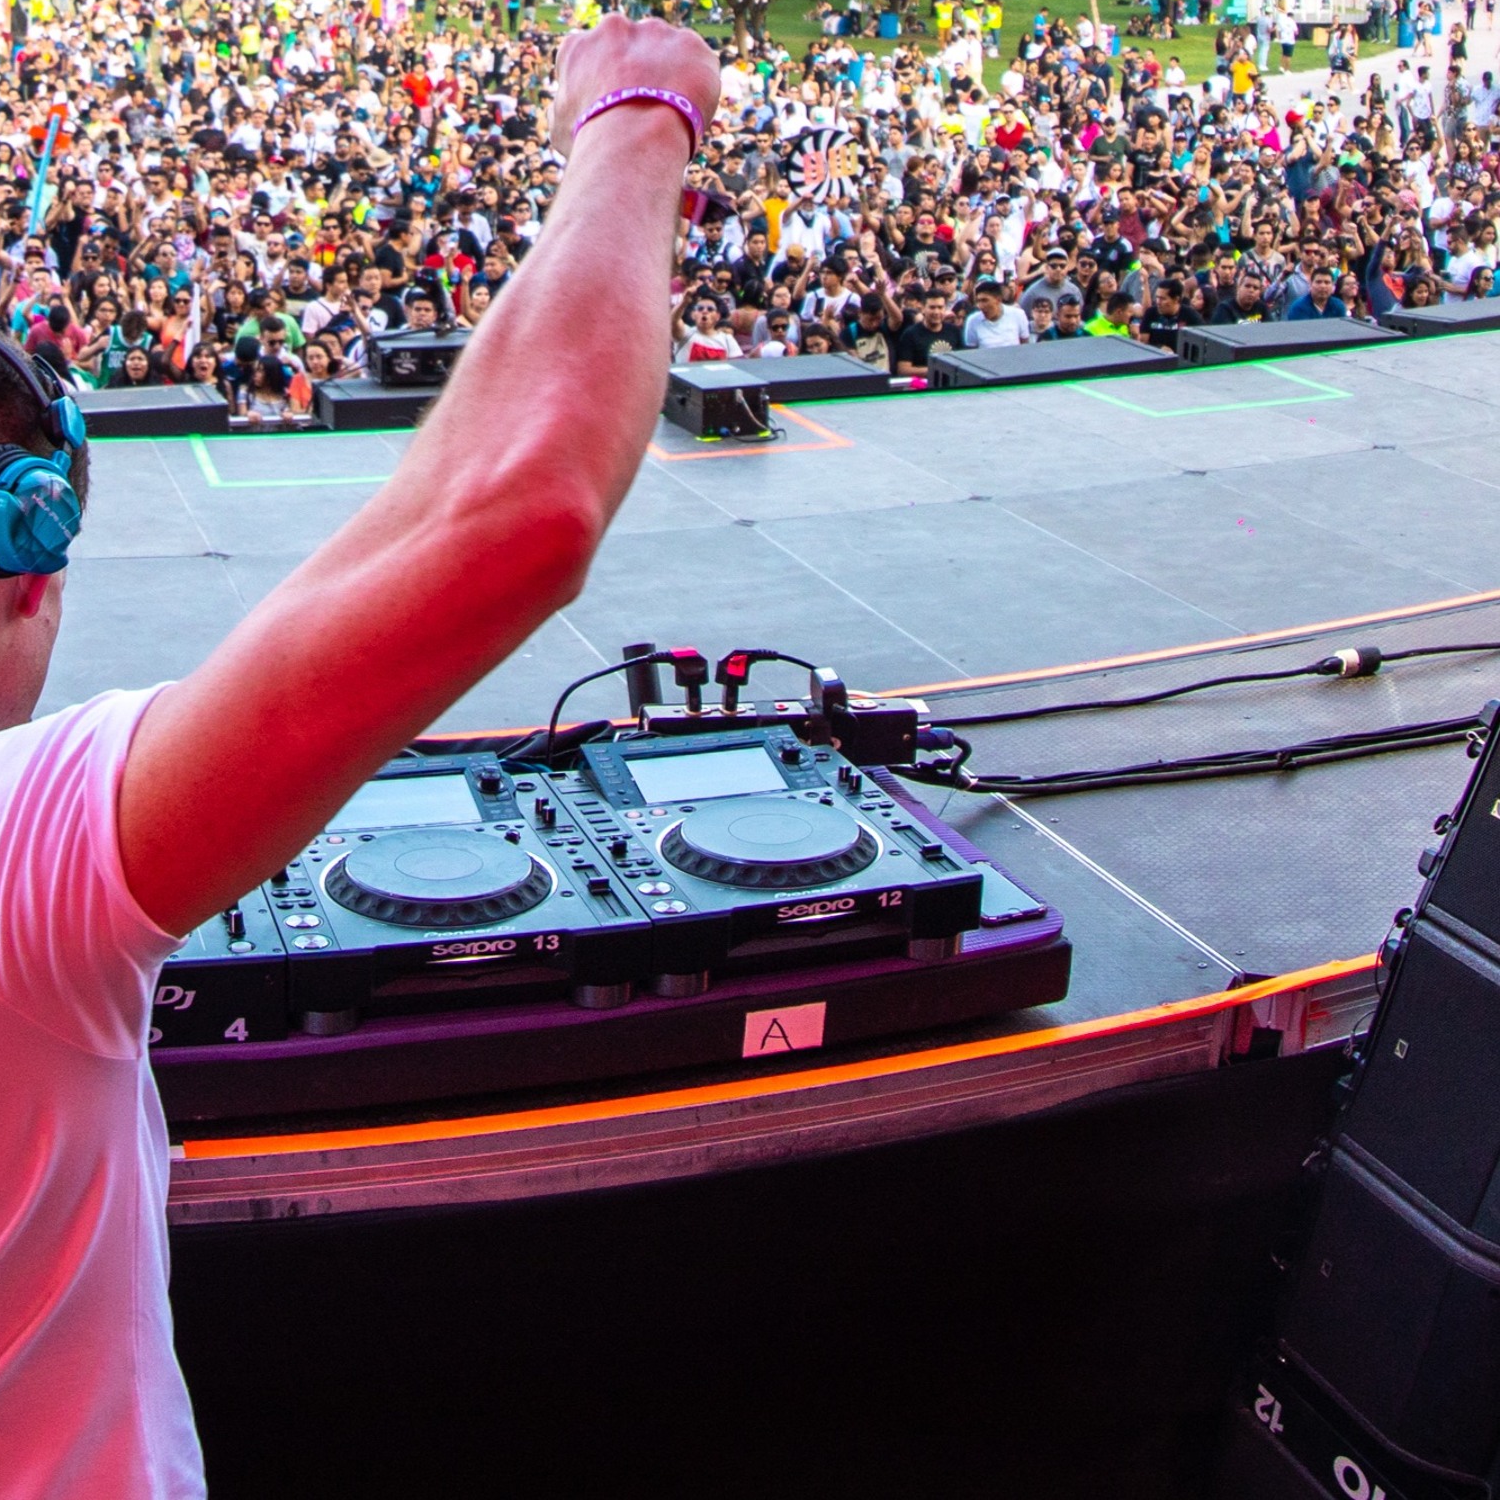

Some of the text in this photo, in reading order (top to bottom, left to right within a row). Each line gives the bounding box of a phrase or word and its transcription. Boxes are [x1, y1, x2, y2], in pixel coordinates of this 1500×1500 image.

[777, 889, 903, 918] serpro 12
[431, 934, 561, 956] serpro 13
[223, 1017, 249, 1042] 4
[759, 1017, 794, 1051] A
[1254, 1382, 1284, 1433] 12
